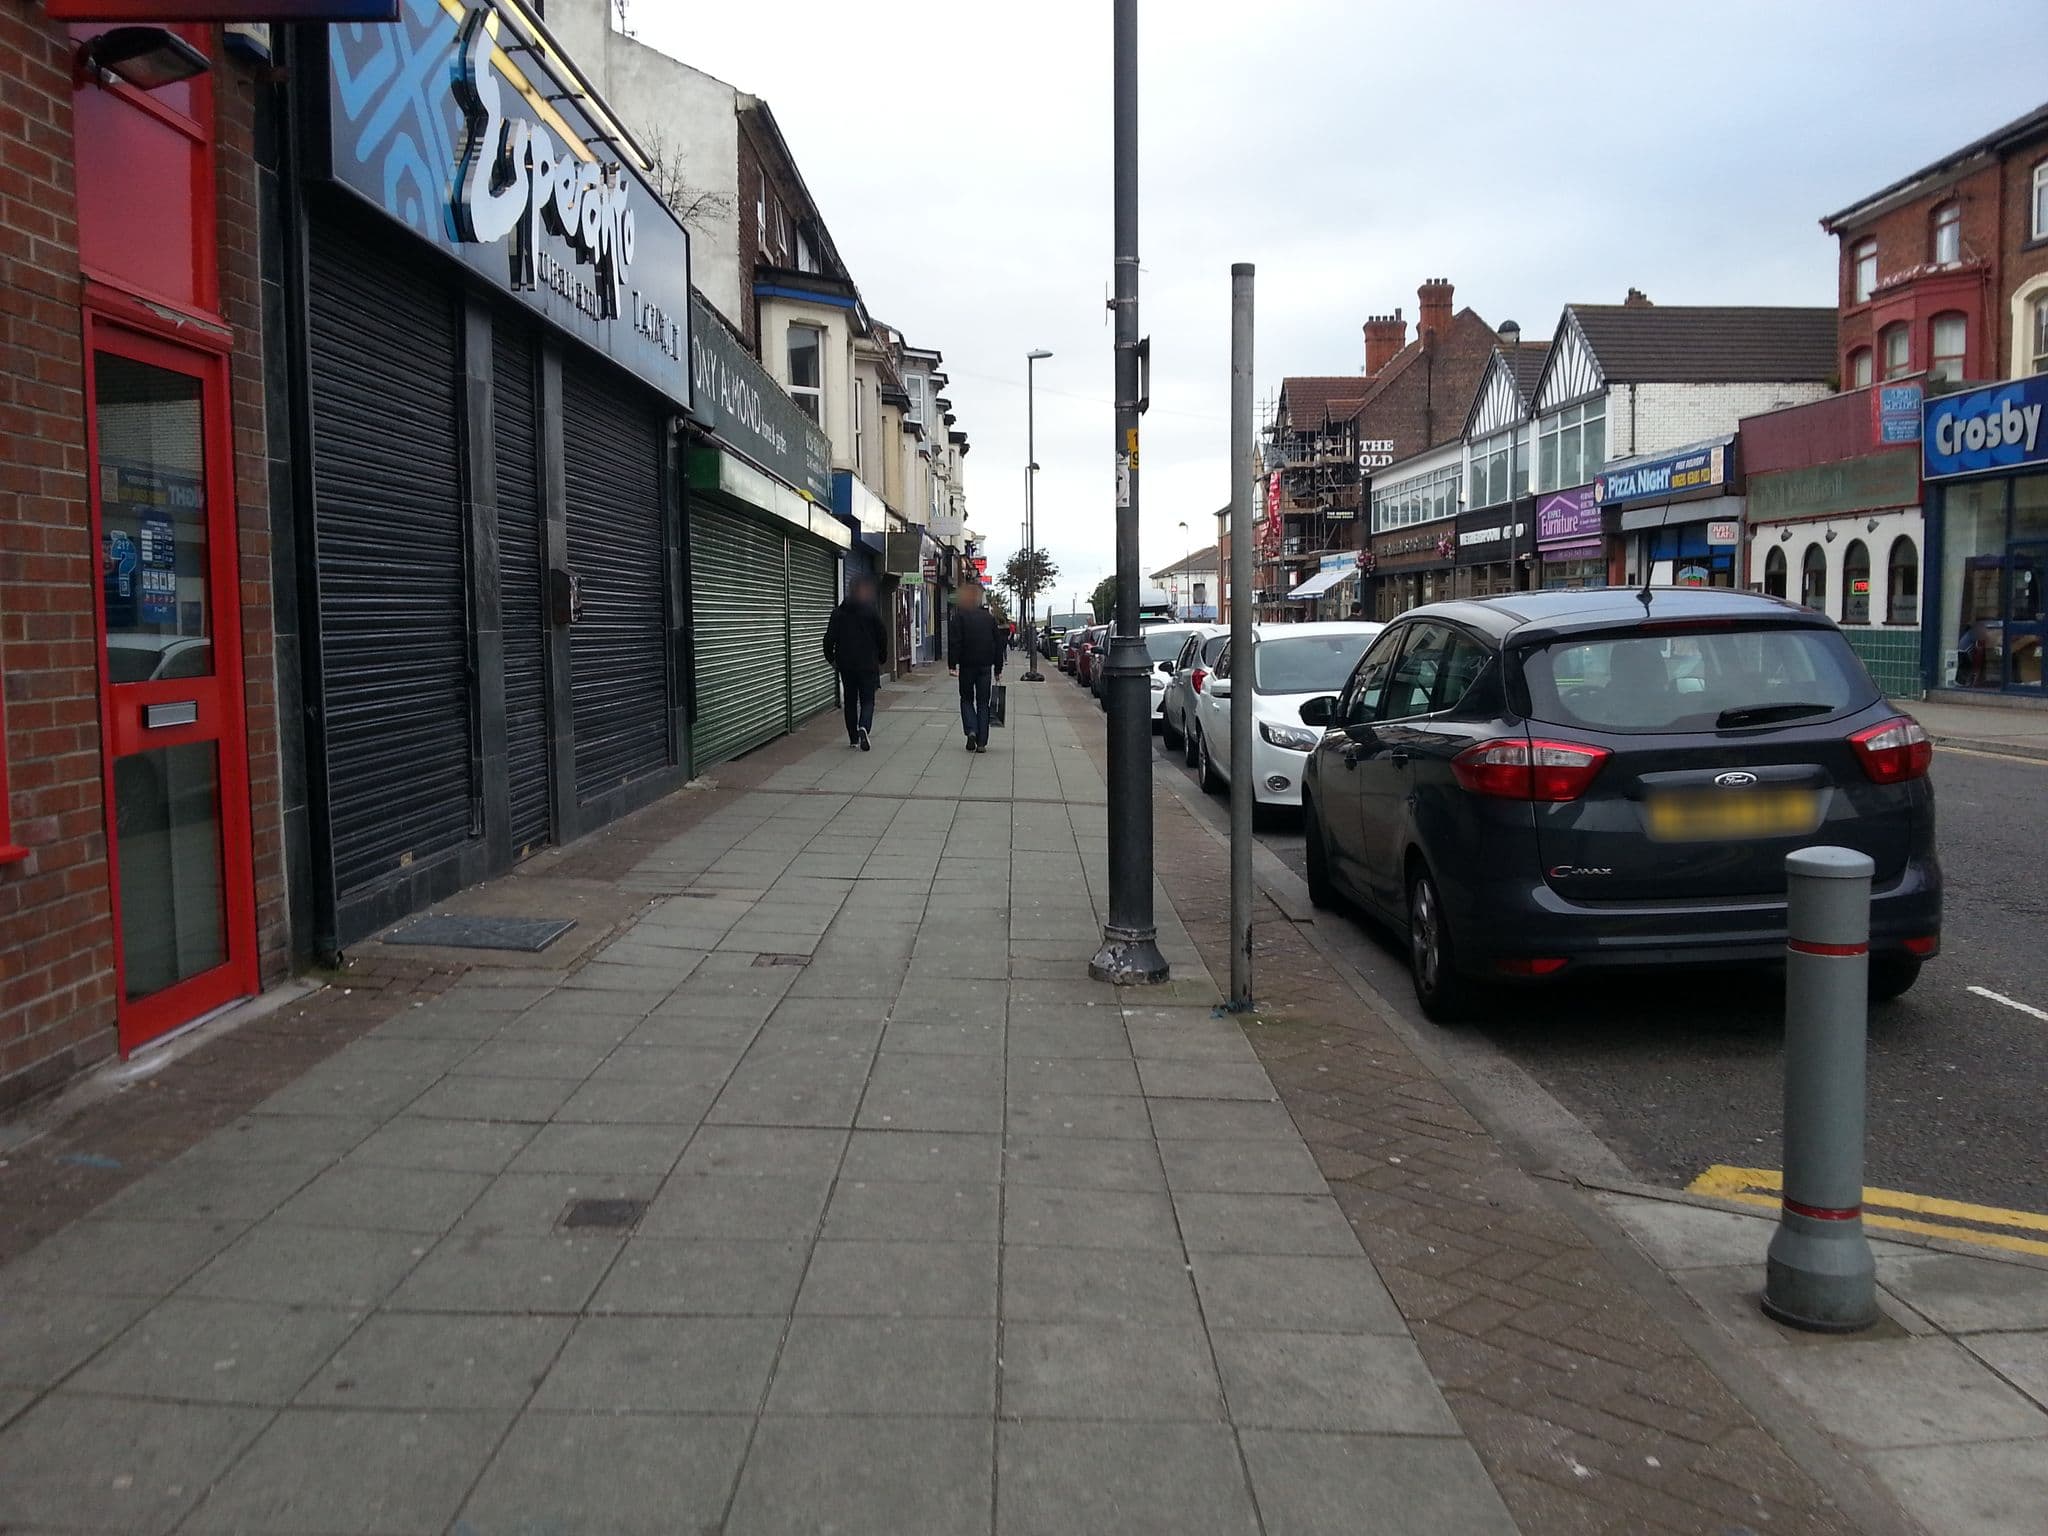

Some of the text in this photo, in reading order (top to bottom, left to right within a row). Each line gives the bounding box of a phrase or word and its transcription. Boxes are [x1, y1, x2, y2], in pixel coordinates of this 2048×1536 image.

[694, 336, 717, 402] ONY
[1935, 399, 2041, 455] Crosby
[1360, 440, 1393, 451] THE
[1359, 455, 1393, 466] OLD
[1638, 468, 1671, 493] NIGHT
[1541, 514, 1579, 537] Furniture
